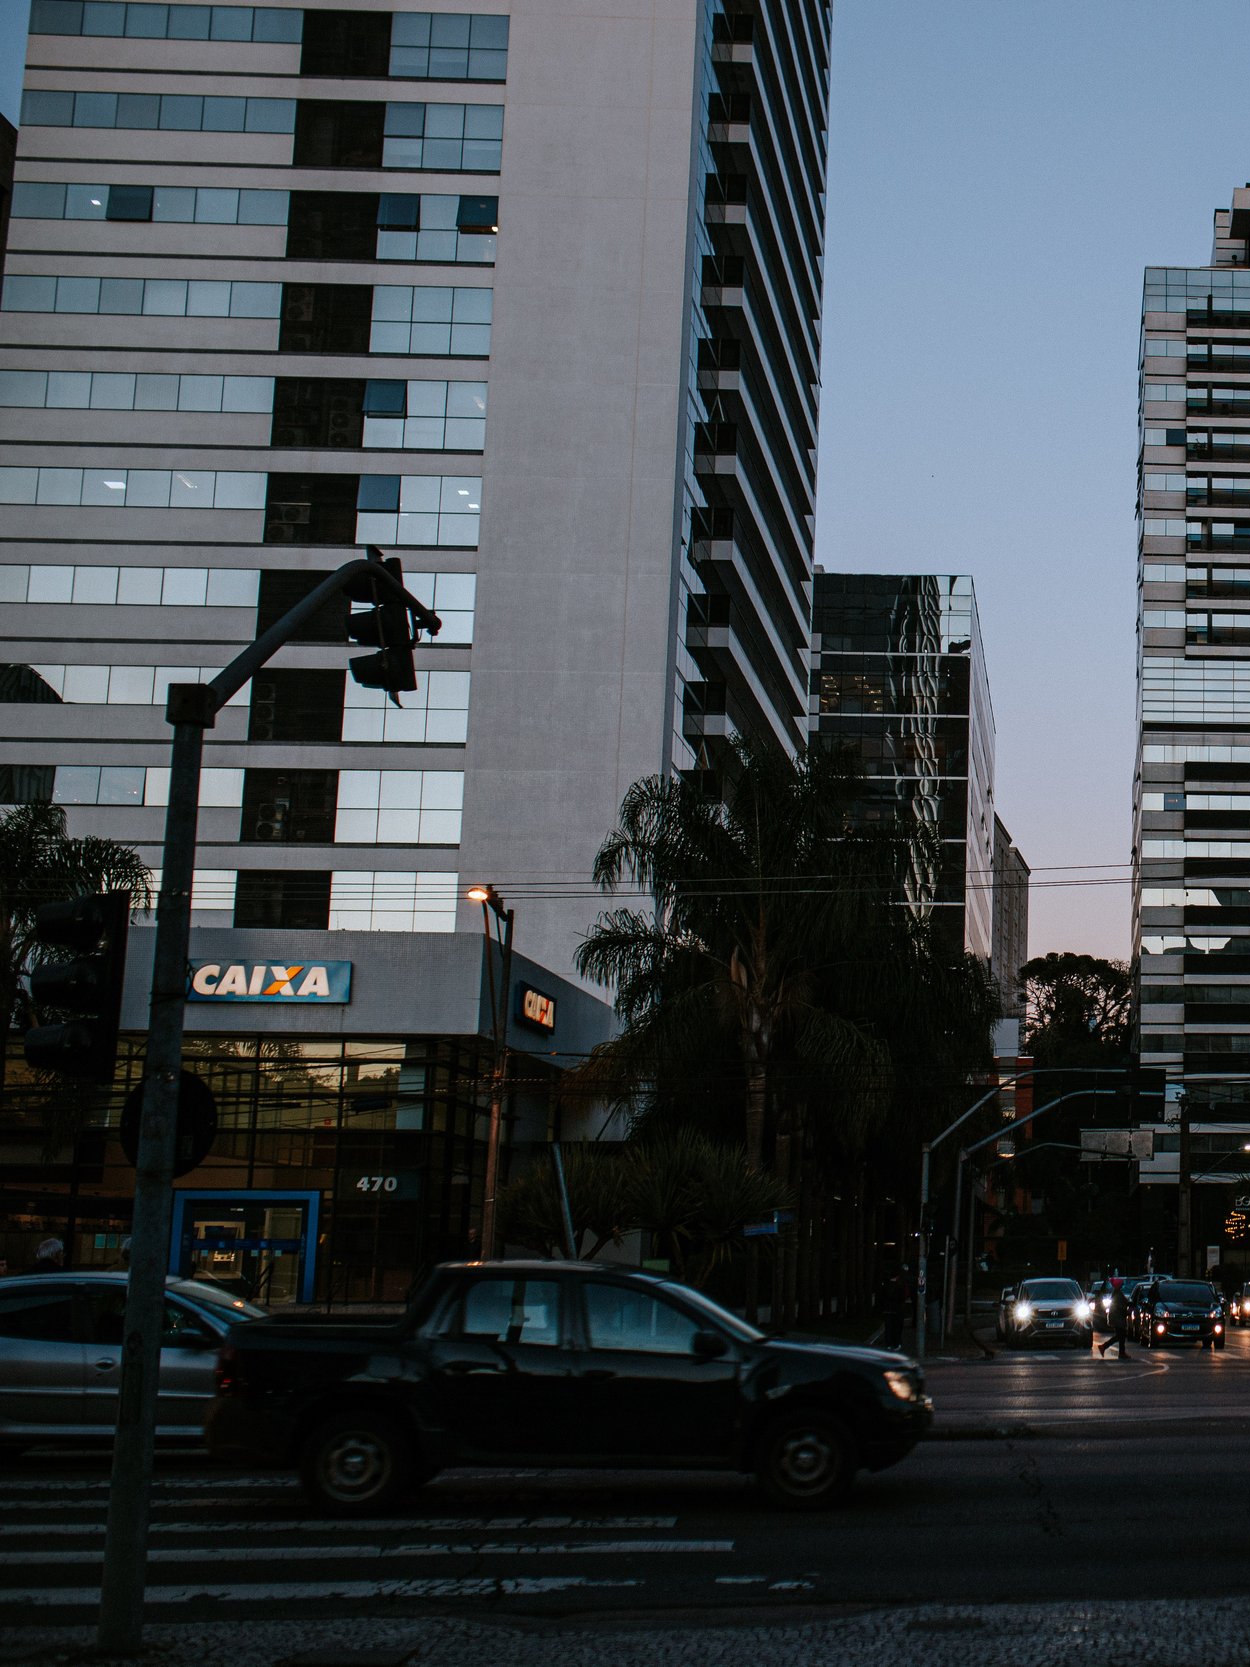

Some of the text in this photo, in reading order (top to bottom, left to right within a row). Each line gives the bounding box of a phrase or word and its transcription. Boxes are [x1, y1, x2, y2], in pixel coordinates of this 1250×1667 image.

[192, 964, 330, 996] CAIXA
[524, 990, 555, 1028] CAIXA
[356, 1176, 398, 1192] 470
